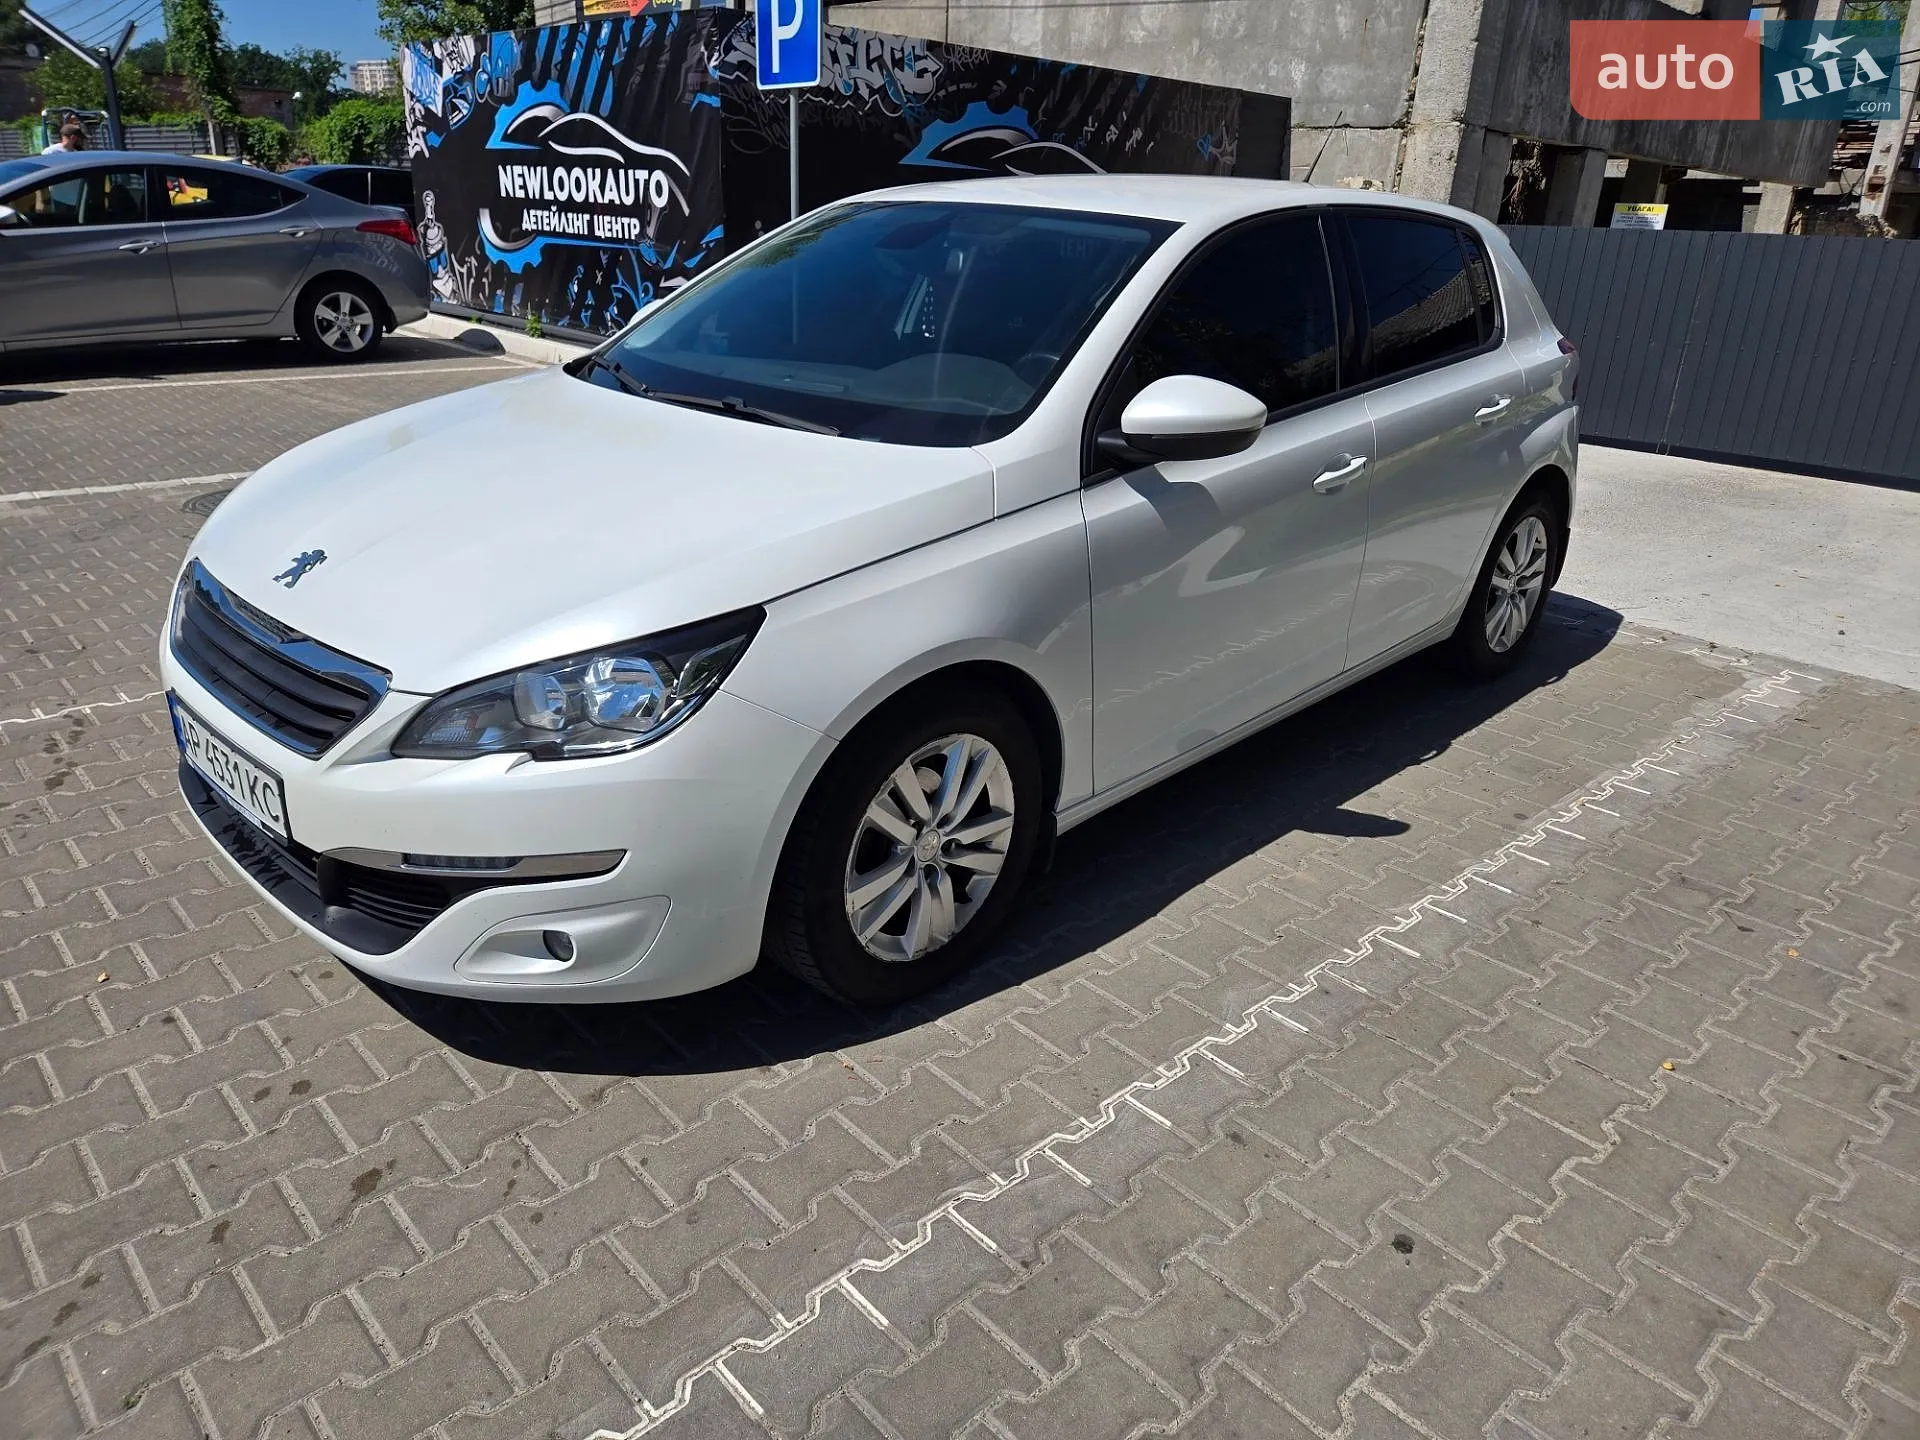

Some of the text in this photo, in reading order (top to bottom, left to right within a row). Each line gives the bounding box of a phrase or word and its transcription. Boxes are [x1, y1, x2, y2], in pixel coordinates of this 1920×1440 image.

[771, 0, 803, 74] P
[498, 165, 669, 208] NEWLOOKAUTO
[522, 205, 640, 240] ДЕТЕЙЛІНГ ЦЕНТР
[180, 714, 280, 823] AP 4531 KC
